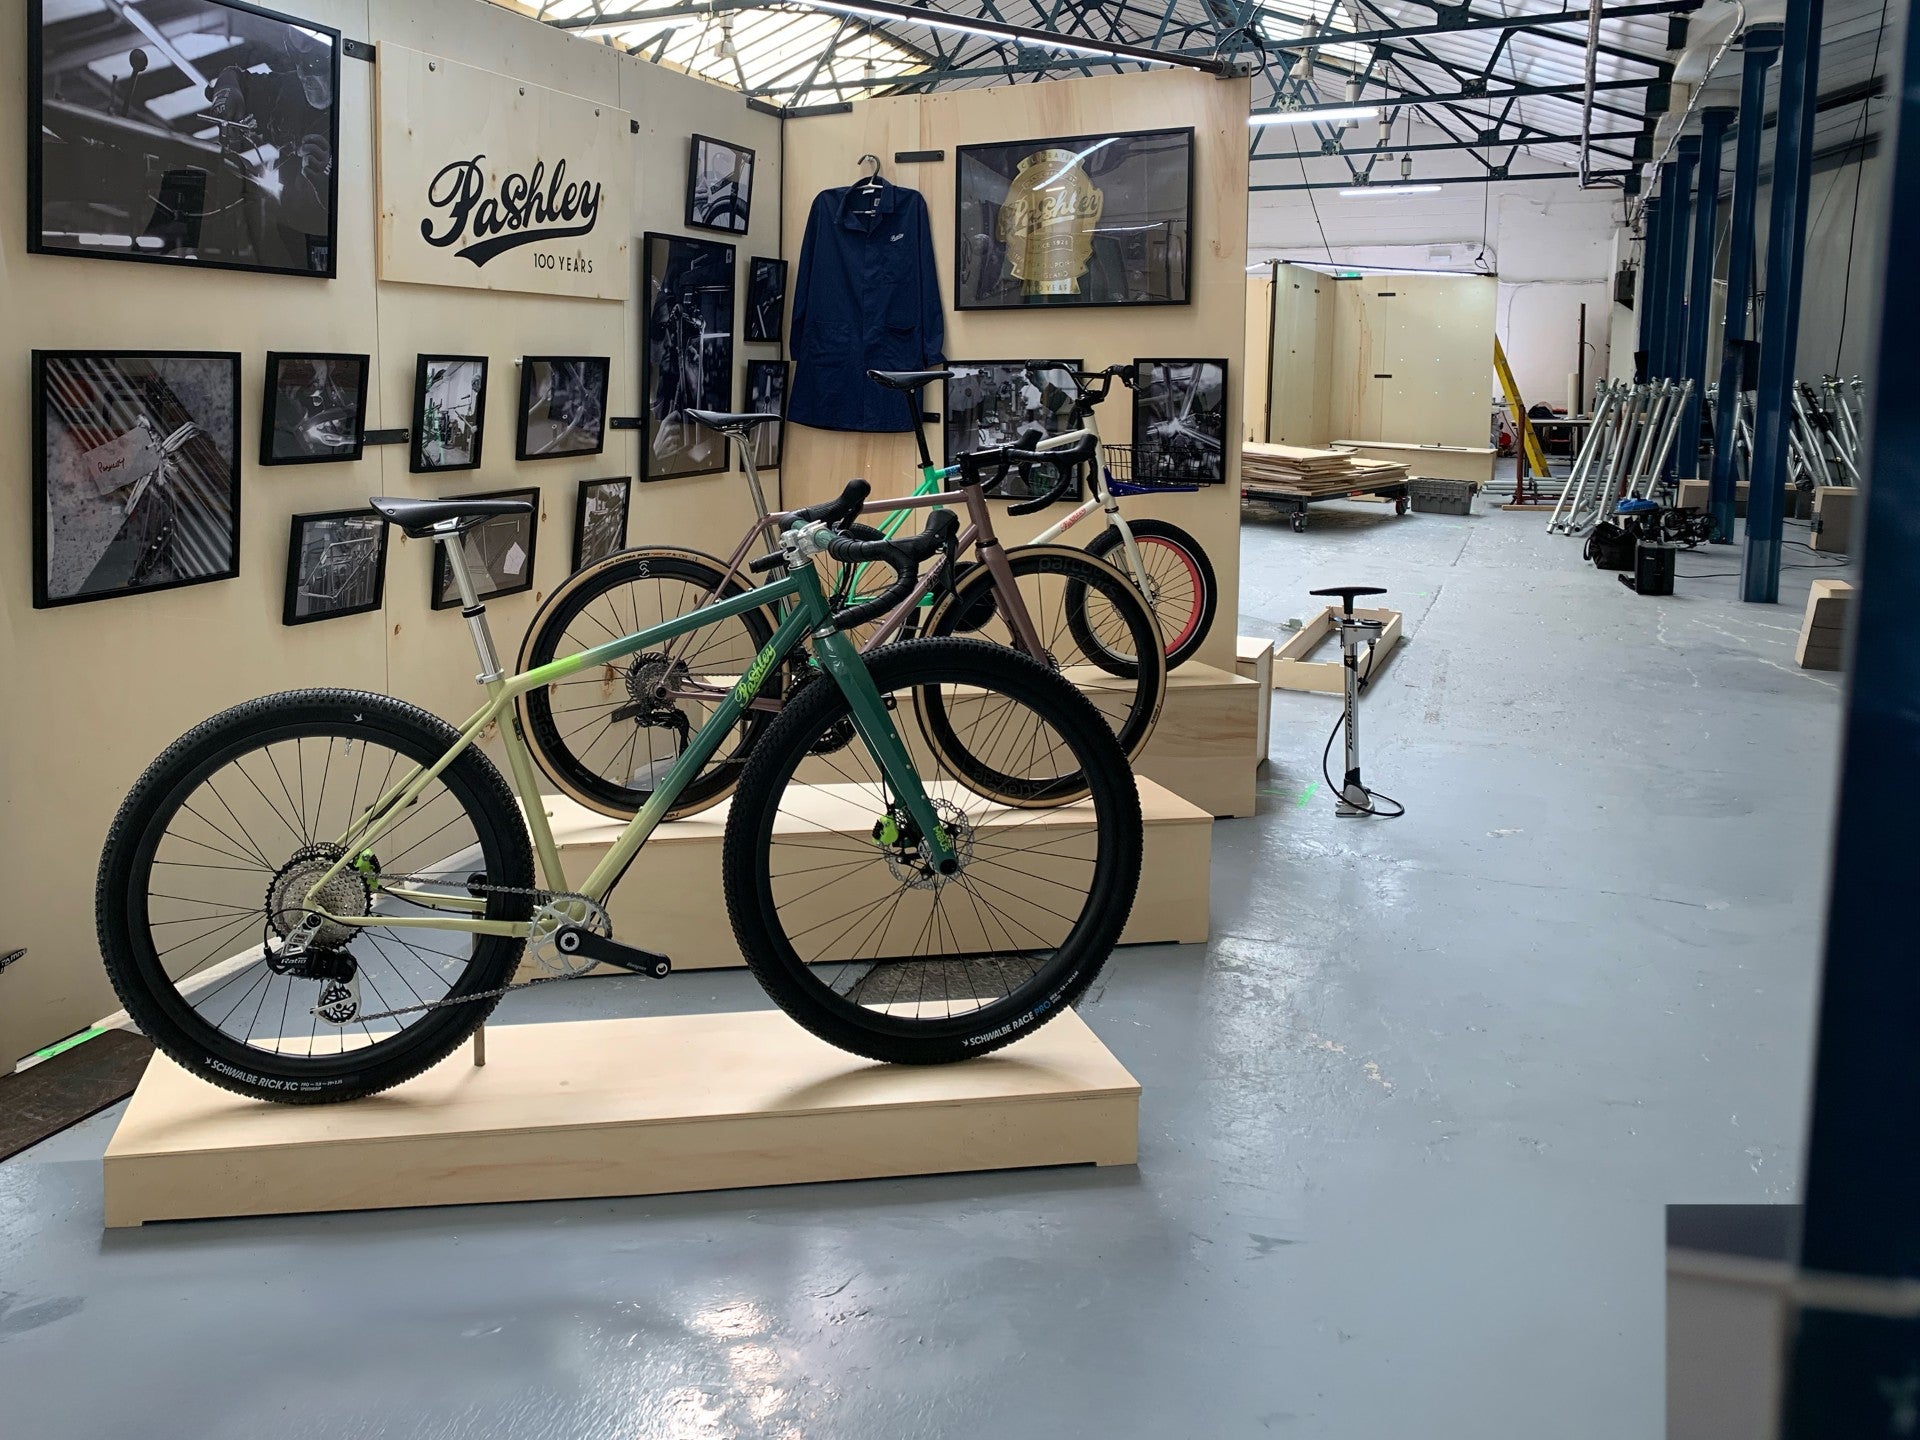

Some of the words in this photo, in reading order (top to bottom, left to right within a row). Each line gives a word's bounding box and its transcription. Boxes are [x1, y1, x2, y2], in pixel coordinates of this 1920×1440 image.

[421, 154, 601, 267] Pashley
[533, 253, 555, 270] 100
[558, 257, 593, 274] YEARS
[735, 644, 777, 708] Pashley
[281, 957, 307, 965] Ratio
[970, 1024, 1013, 1047] SCHWALBE
[1012, 1011, 1035, 1030] RACE
[1034, 1000, 1051, 1017] PRO
[211, 1060, 258, 1084] SCHWALBE
[258, 1077, 282, 1091] RICK
[283, 1081, 299, 1092] XC
